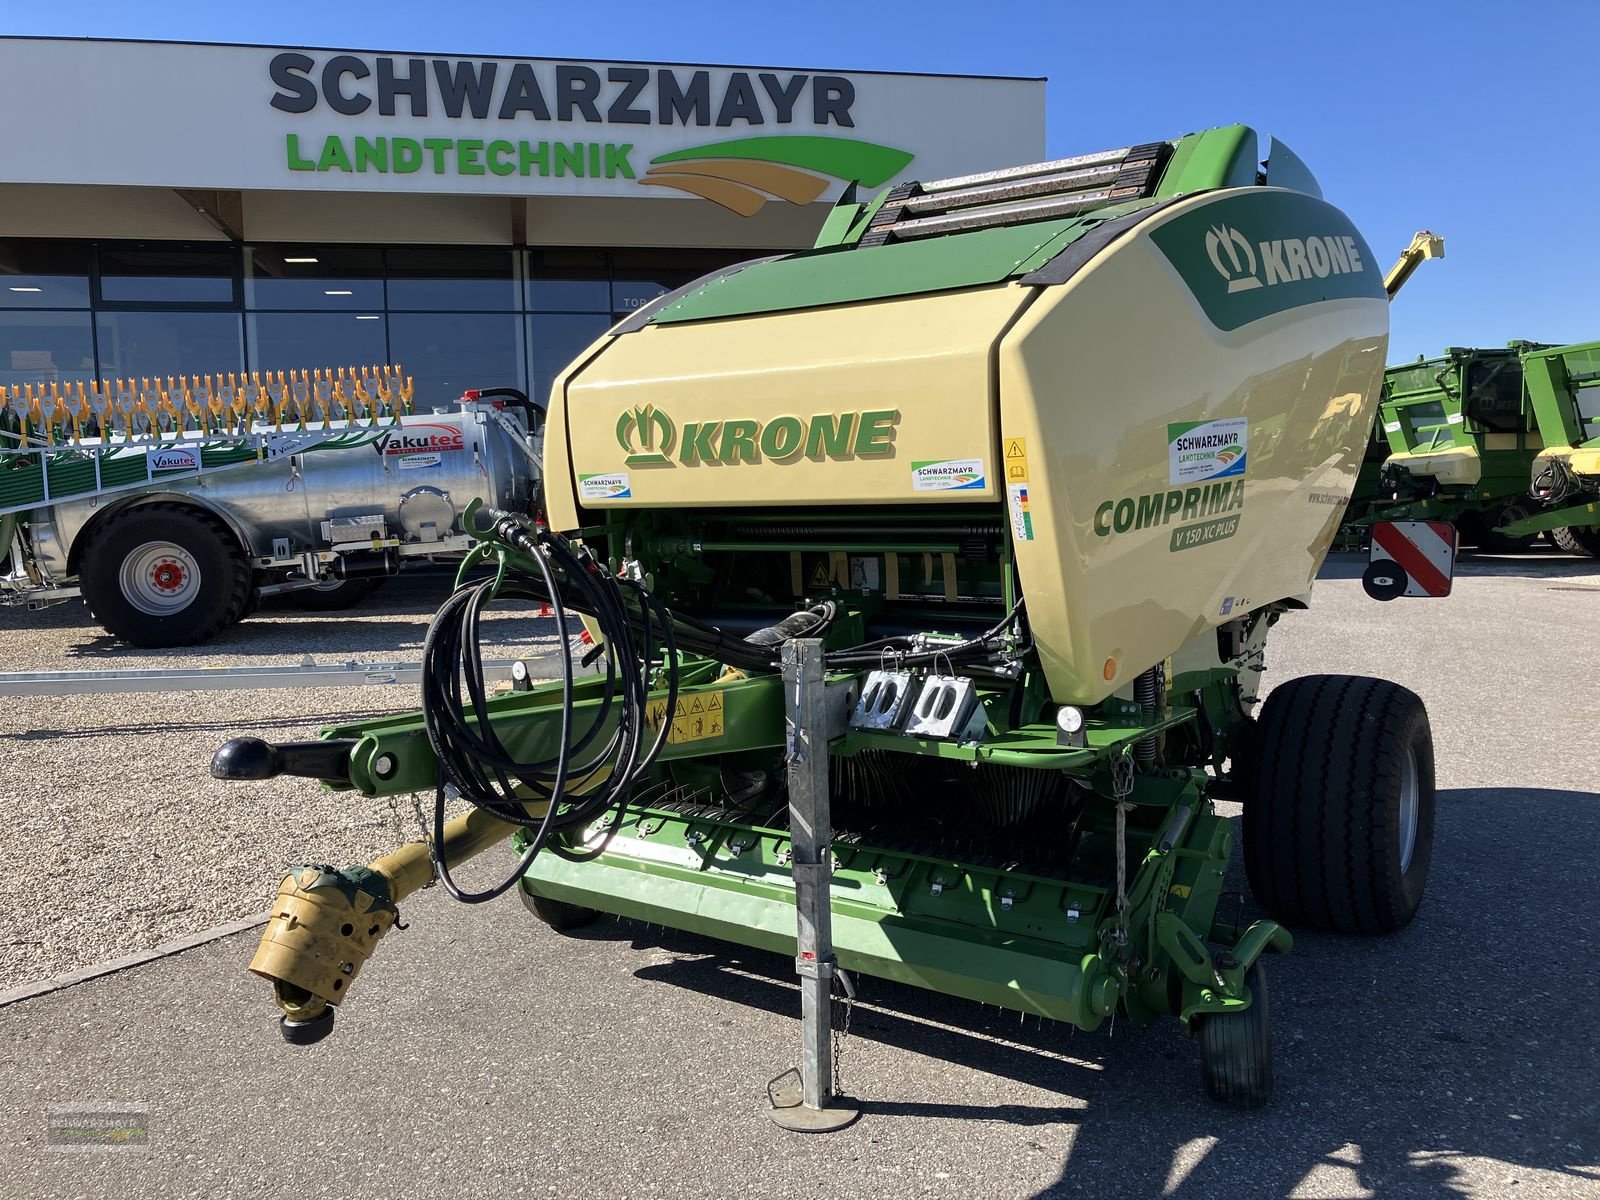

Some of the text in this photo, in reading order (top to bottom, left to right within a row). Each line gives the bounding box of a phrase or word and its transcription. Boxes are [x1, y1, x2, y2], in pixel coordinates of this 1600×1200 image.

[268, 52, 856, 128] SCHWARZMAYR
[286, 133, 636, 179] LANDTECHNIK
[1259, 235, 1364, 286] KRONE
[372, 433, 464, 456] Vakutec
[679, 408, 902, 468] KRONE
[1177, 432, 1239, 451] SCHWARZMAYR
[152, 455, 196, 469] Vakutec
[918, 467, 973, 475] SCHWARZMAYR
[1178, 451, 1216, 463] LANDTECHNIK
[1093, 479, 1245, 537] COMPRIMA
[1176, 519, 1237, 547] V 150 XC PLUS
